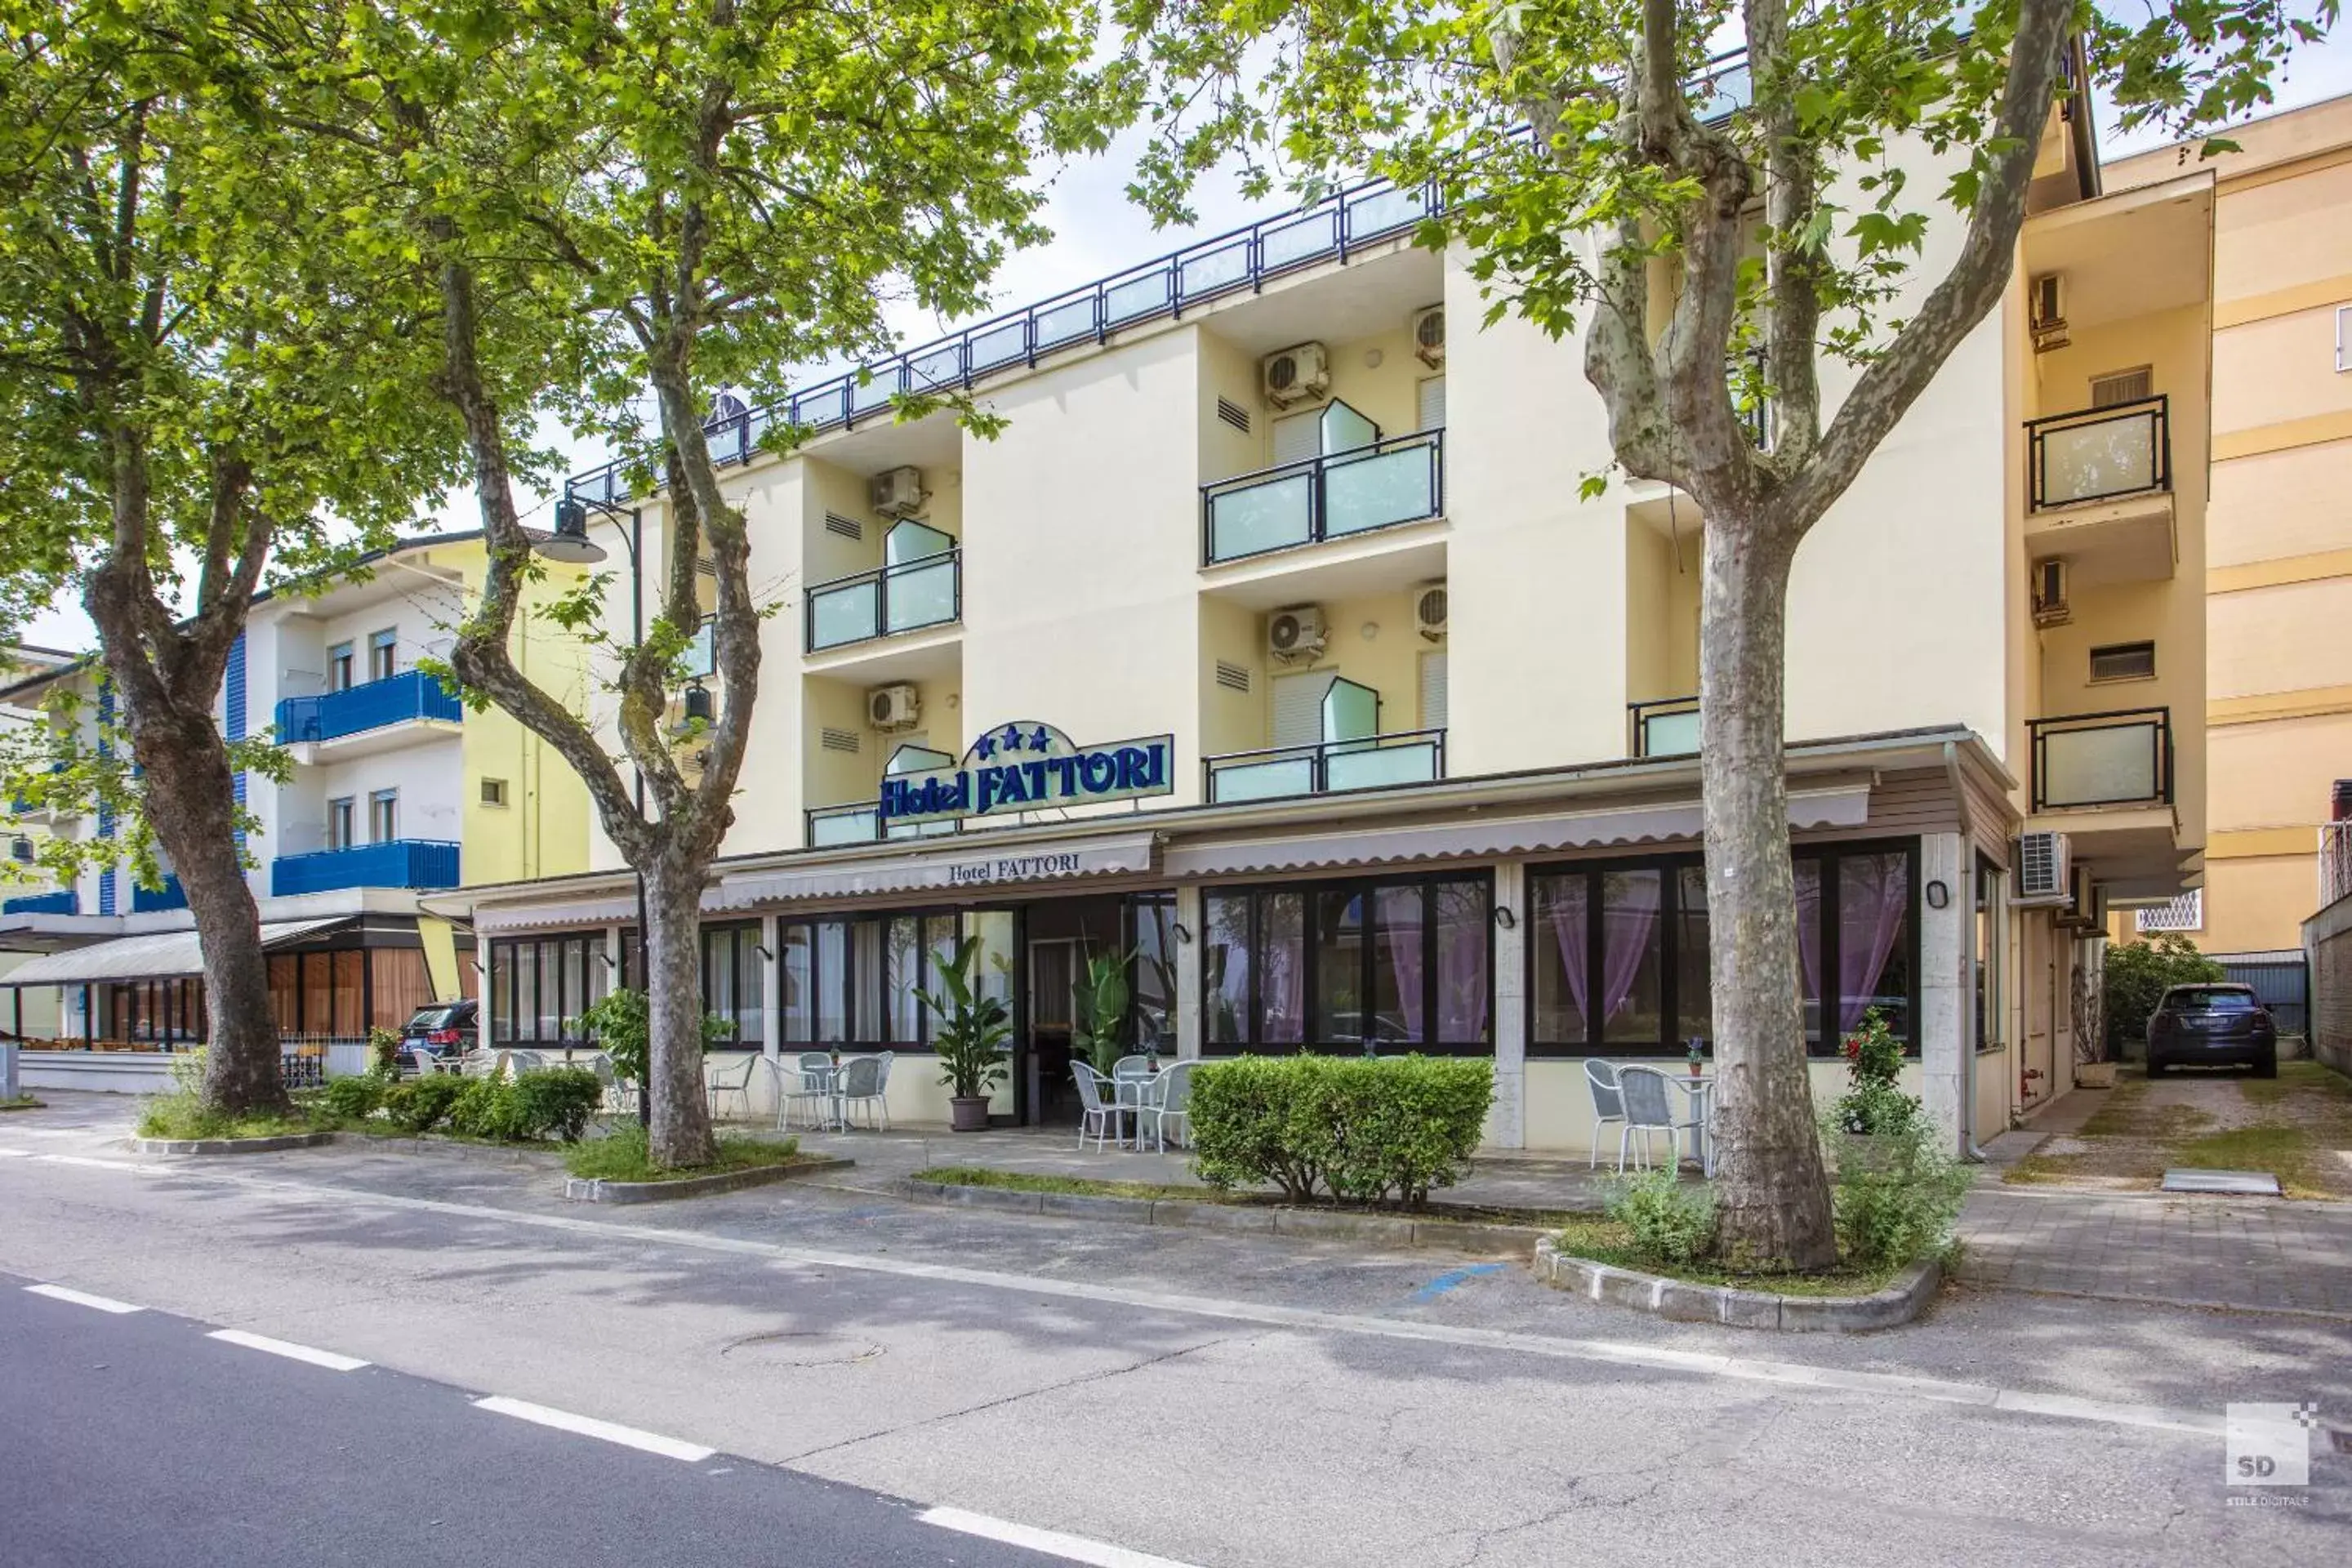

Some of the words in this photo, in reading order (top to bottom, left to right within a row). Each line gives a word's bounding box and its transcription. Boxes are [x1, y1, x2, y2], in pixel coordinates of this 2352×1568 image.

[880, 770, 969, 818] Hotel
[976, 744, 1165, 814] FATTORI
[949, 862, 991, 882] Hotel
[998, 853, 1079, 877] FATTORI
